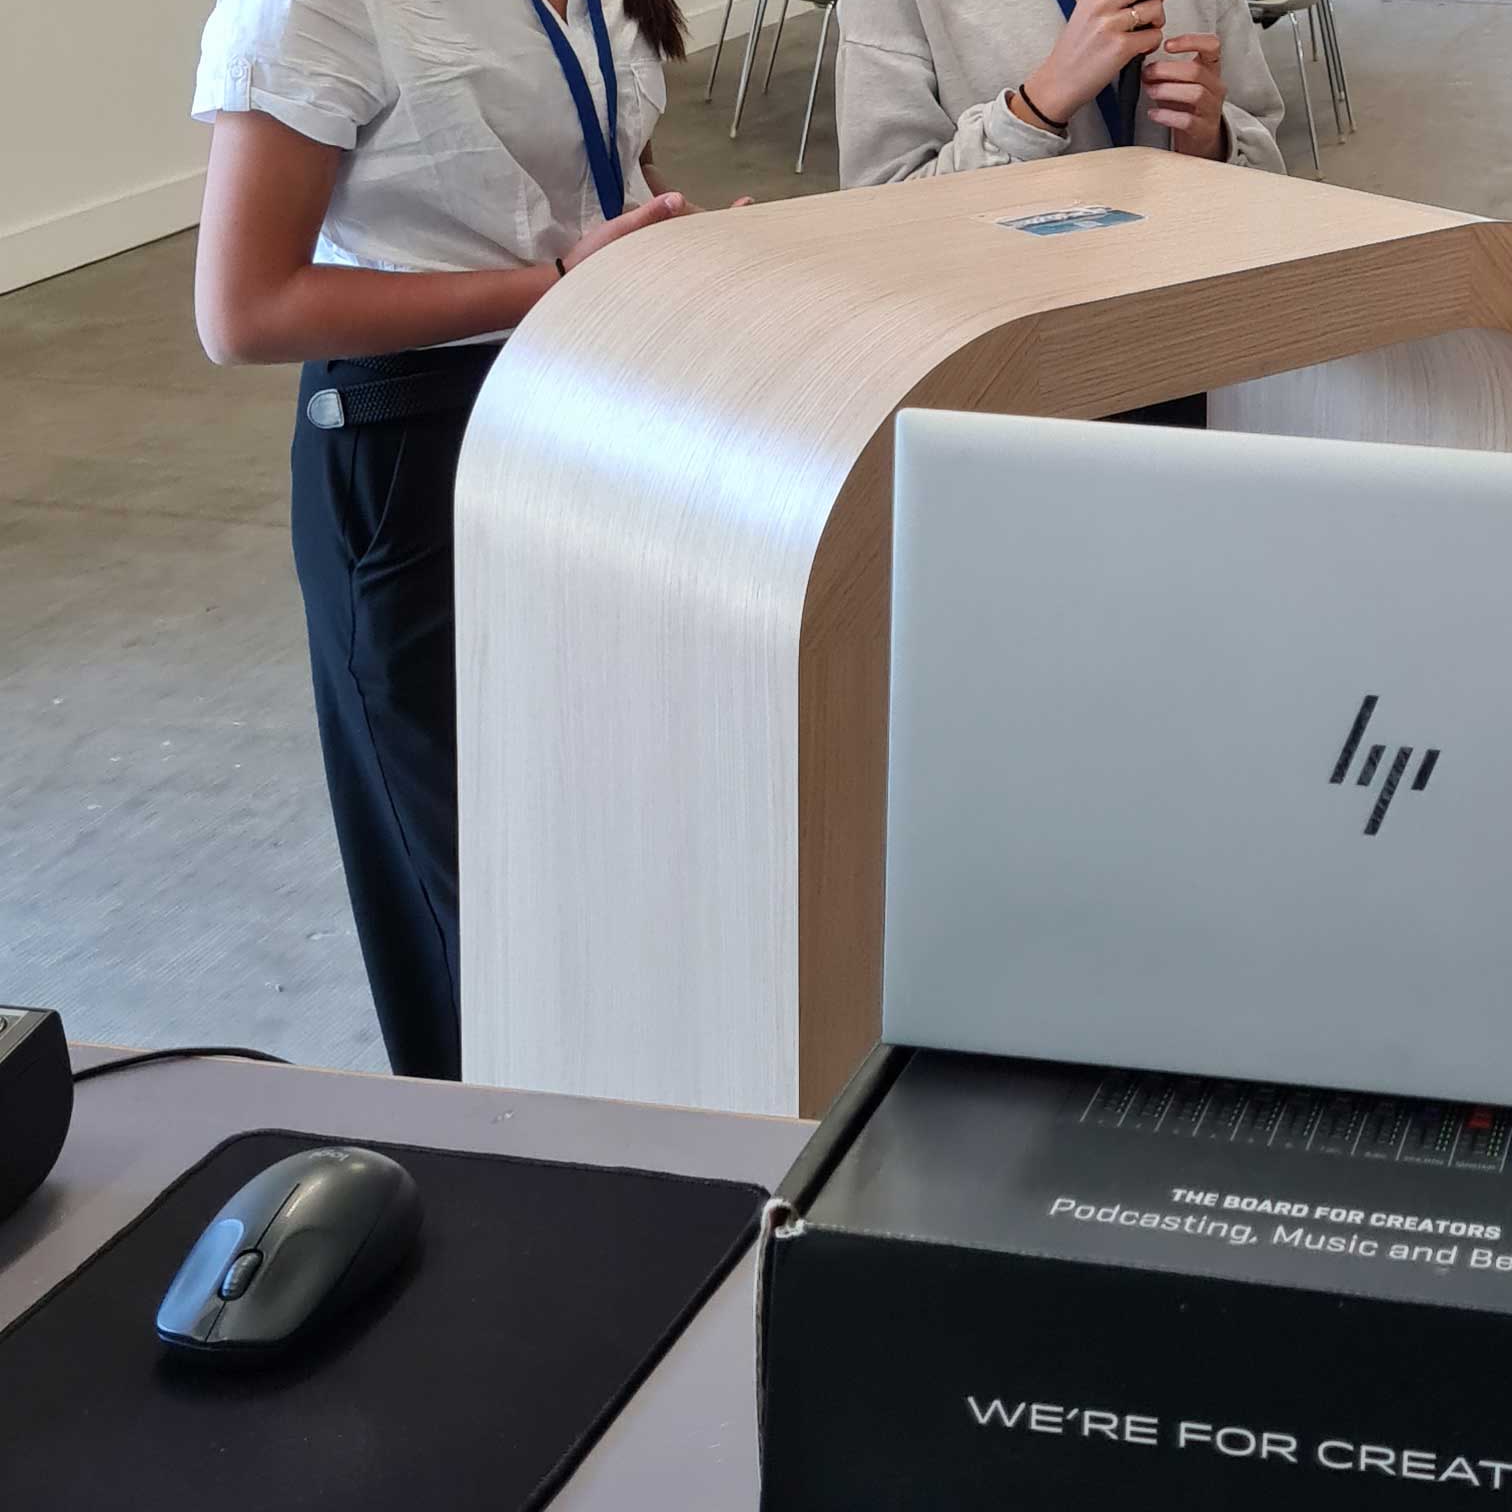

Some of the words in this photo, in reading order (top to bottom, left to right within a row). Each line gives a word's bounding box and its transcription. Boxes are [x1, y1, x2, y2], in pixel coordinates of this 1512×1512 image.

[1329, 694, 1441, 836] hp
[1049, 1197, 1258, 1246] Podcasting,
[1272, 1224, 1379, 1257] Music
[1388, 1243, 1459, 1266] and
[1171, 1187, 1220, 1208] THE
[1222, 1194, 1310, 1219] BOARD
[1313, 1204, 1366, 1225] FOR
[1369, 1211, 1503, 1240] CREATORS
[966, 1395, 1160, 1446] WE'RE
[1177, 1420, 1299, 1464] FOR
